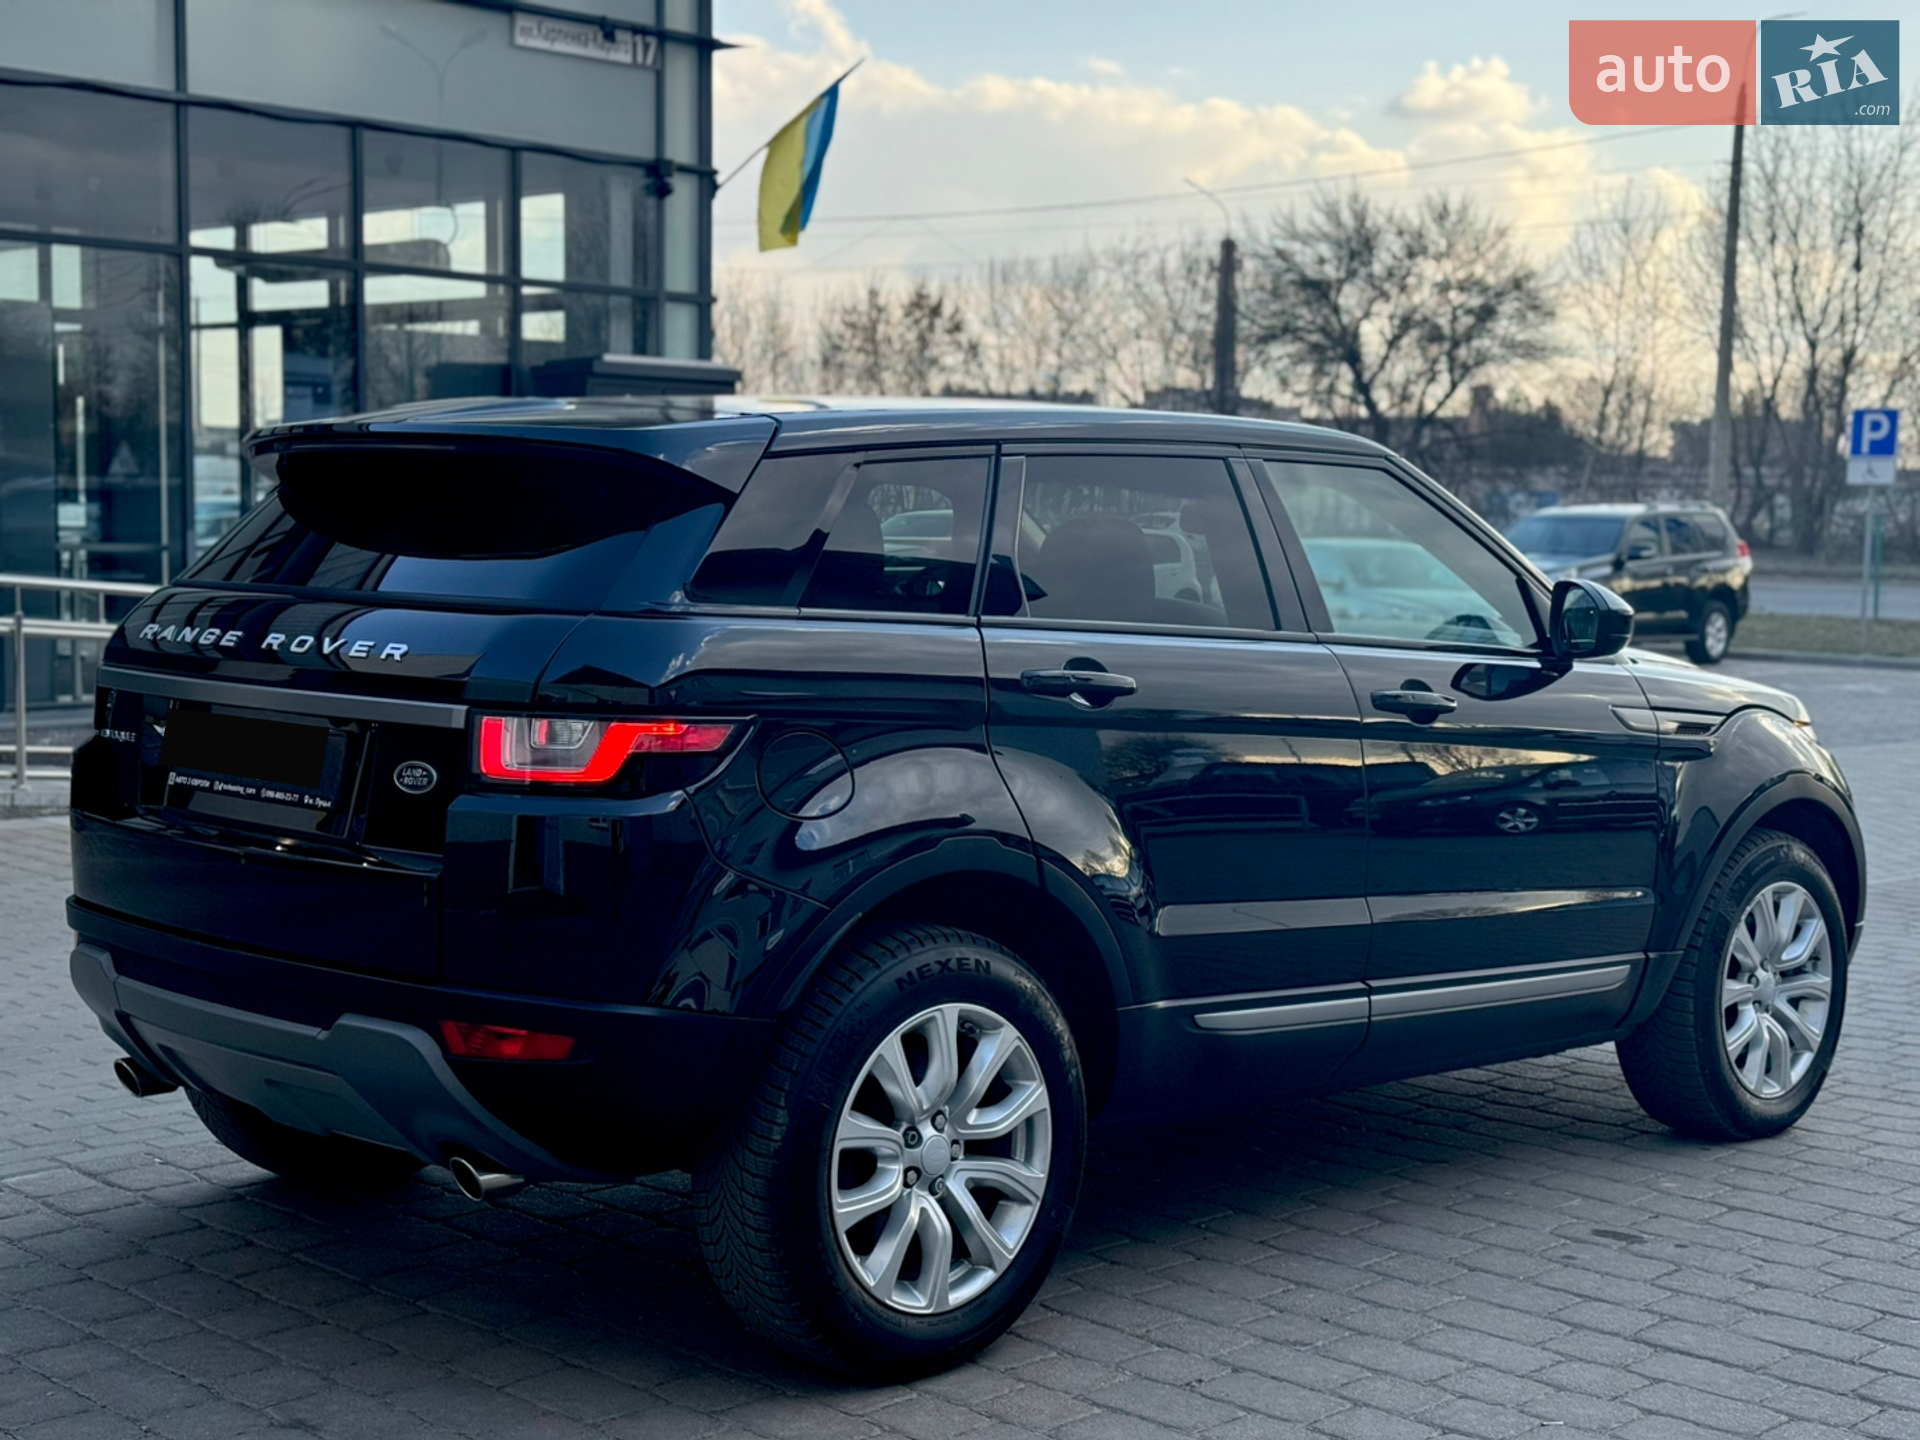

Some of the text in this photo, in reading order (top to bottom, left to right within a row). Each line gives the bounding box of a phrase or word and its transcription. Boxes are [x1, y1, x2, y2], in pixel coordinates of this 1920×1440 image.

[633, 33, 658, 66] 17
[1861, 412, 1891, 455] P
[139, 623, 410, 662] RANGE ROVER
[402, 767, 423, 778] LAND
[403, 776, 428, 786] ROVER
[894, 957, 992, 992] NEXEN
